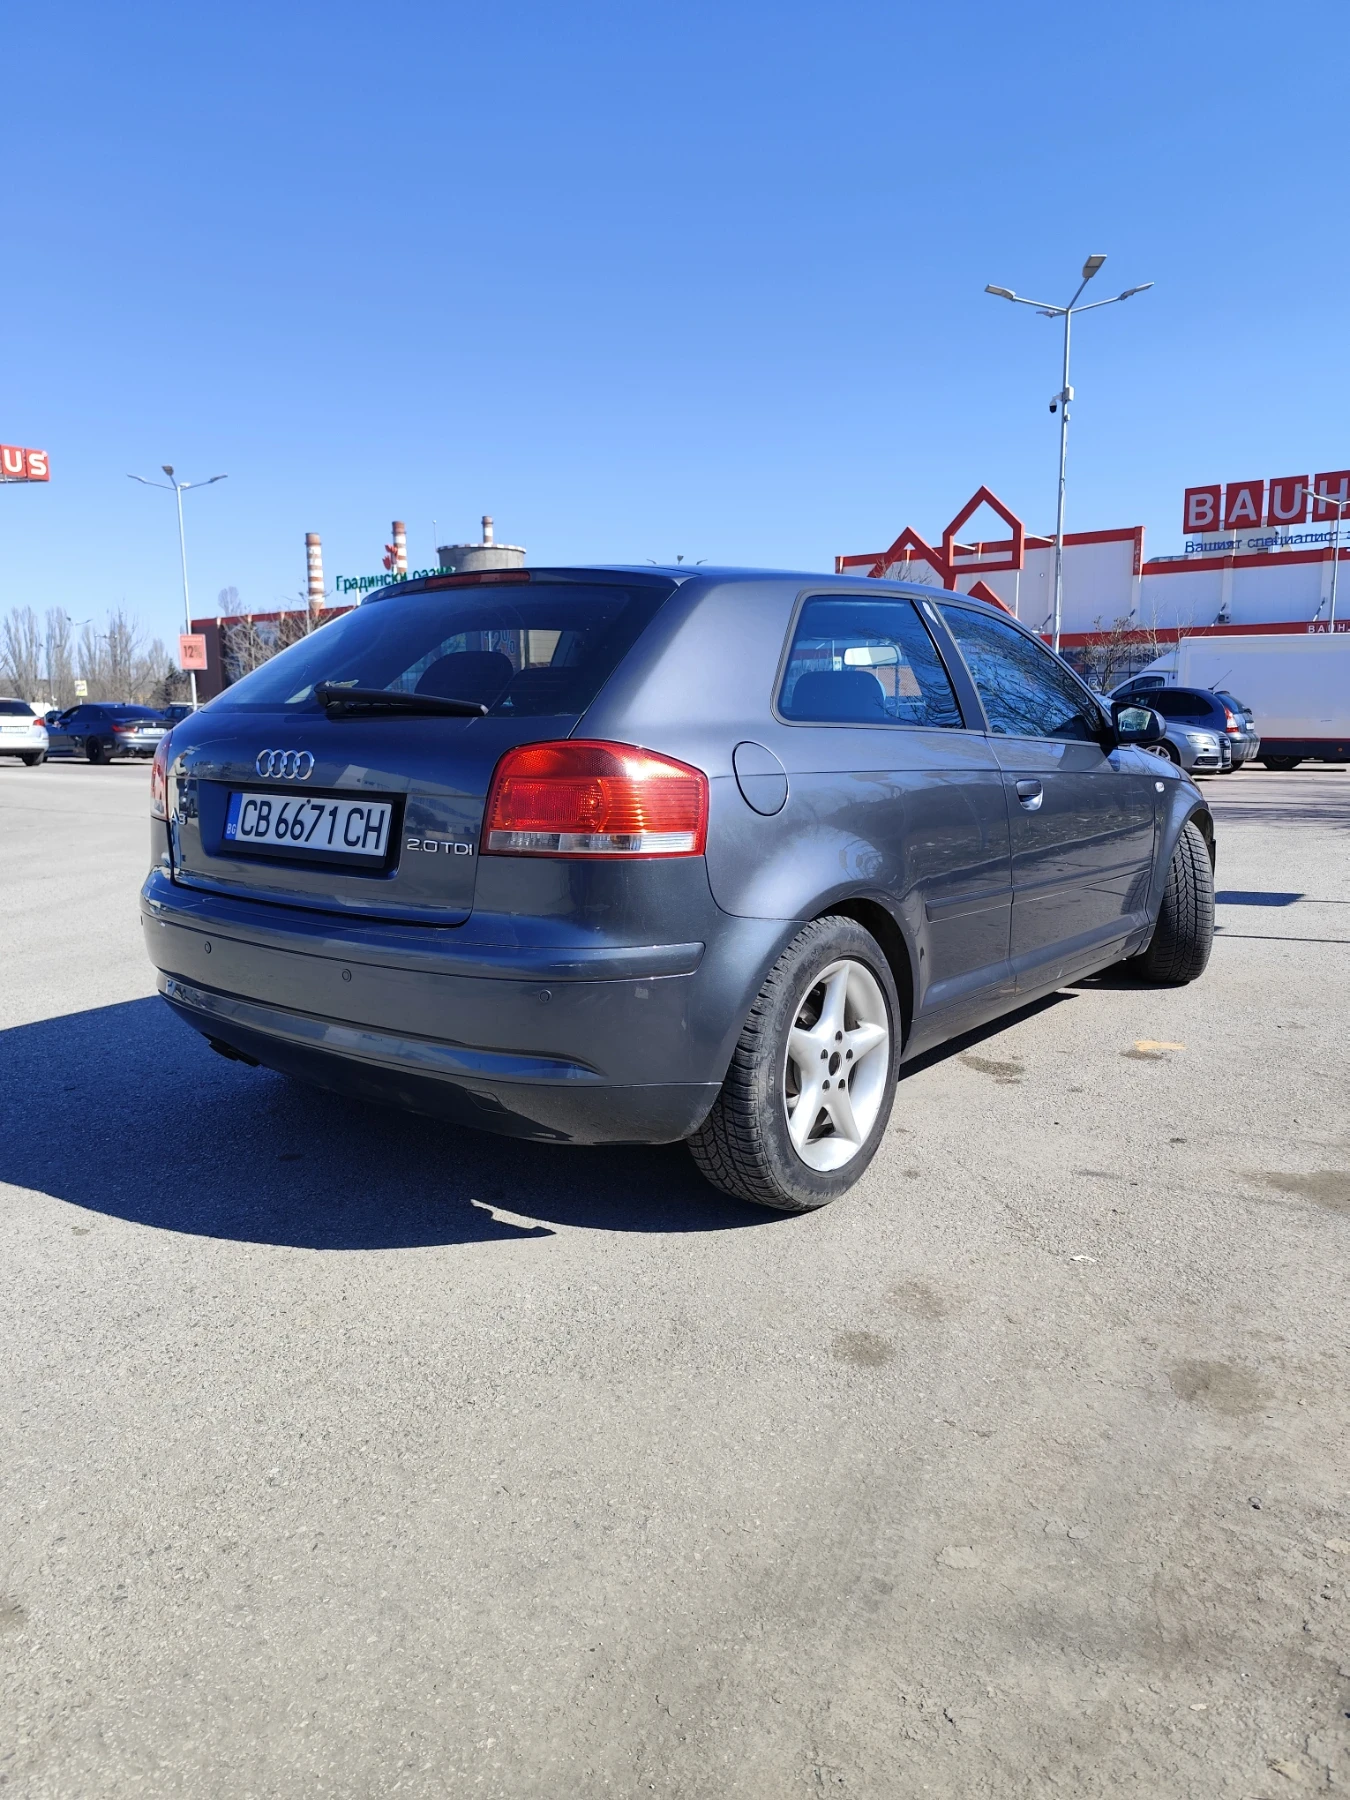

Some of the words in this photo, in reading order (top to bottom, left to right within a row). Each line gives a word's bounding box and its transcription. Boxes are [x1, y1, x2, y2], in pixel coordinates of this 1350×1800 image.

[1188, 478, 1349, 527] BAUH
[1185, 540, 1242, 553] Вашият
[336, 572, 408, 594] Градински
[1308, 623, 1350, 633] BAUH
[226, 823, 237, 835] BG
[406, 838, 438, 853] 2.0
[440, 841, 473, 856] TDI
